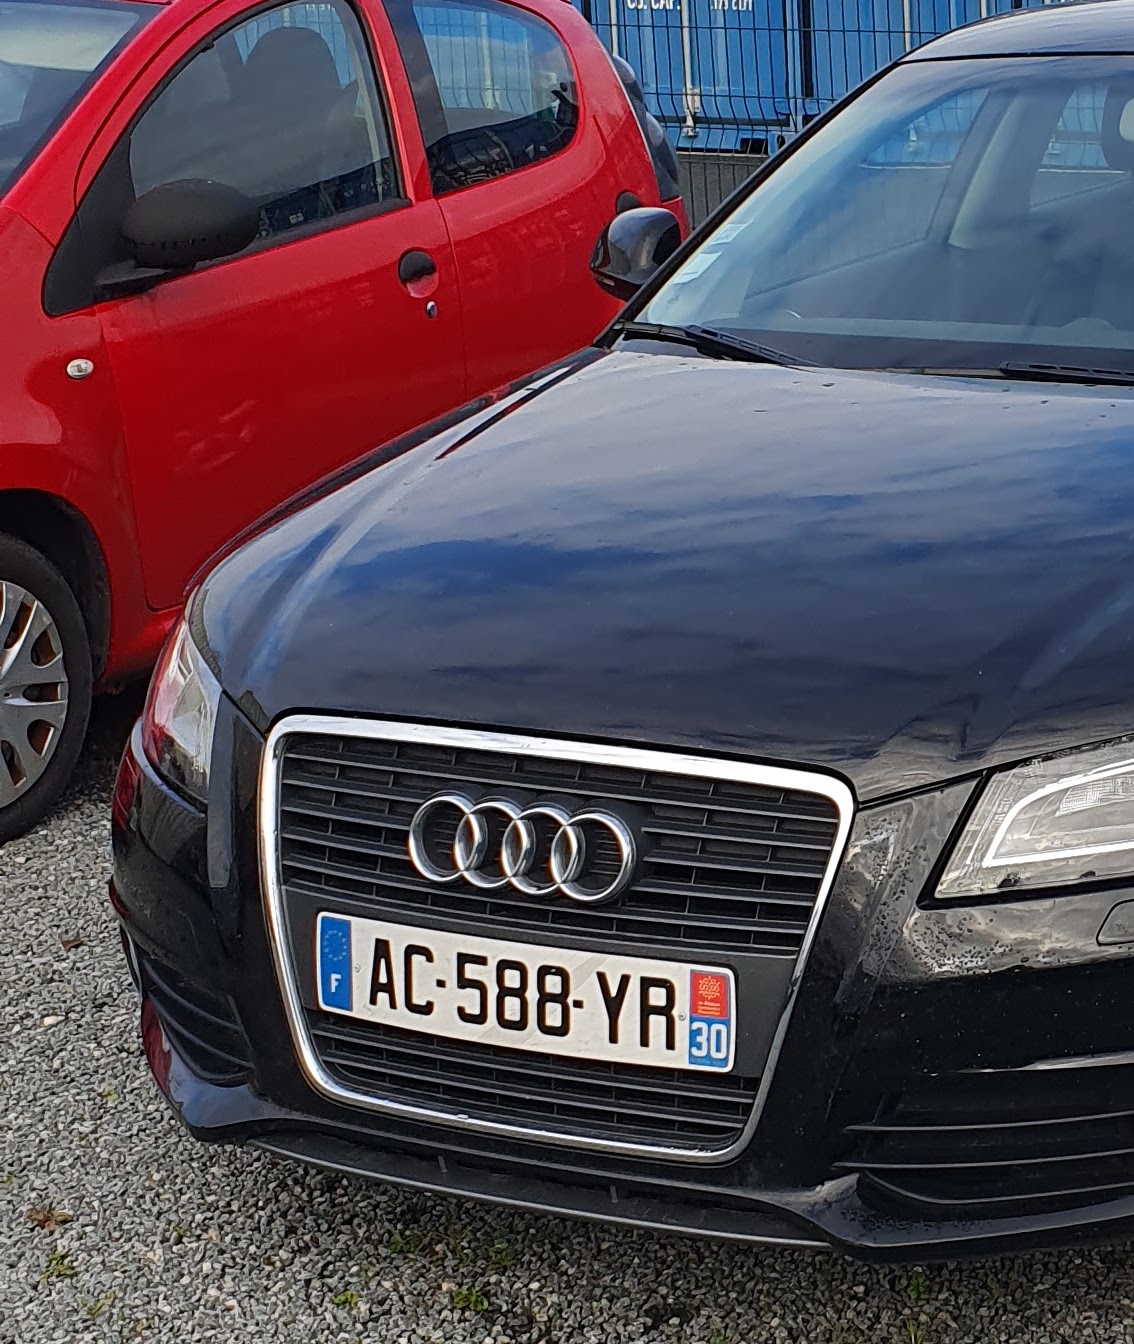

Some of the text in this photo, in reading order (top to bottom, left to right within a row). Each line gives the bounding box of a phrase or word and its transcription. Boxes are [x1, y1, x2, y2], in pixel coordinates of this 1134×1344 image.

[330, 973, 341, 993] F
[368, 938, 676, 1050] AC-588-YR
[691, 1021, 727, 1059] 30
